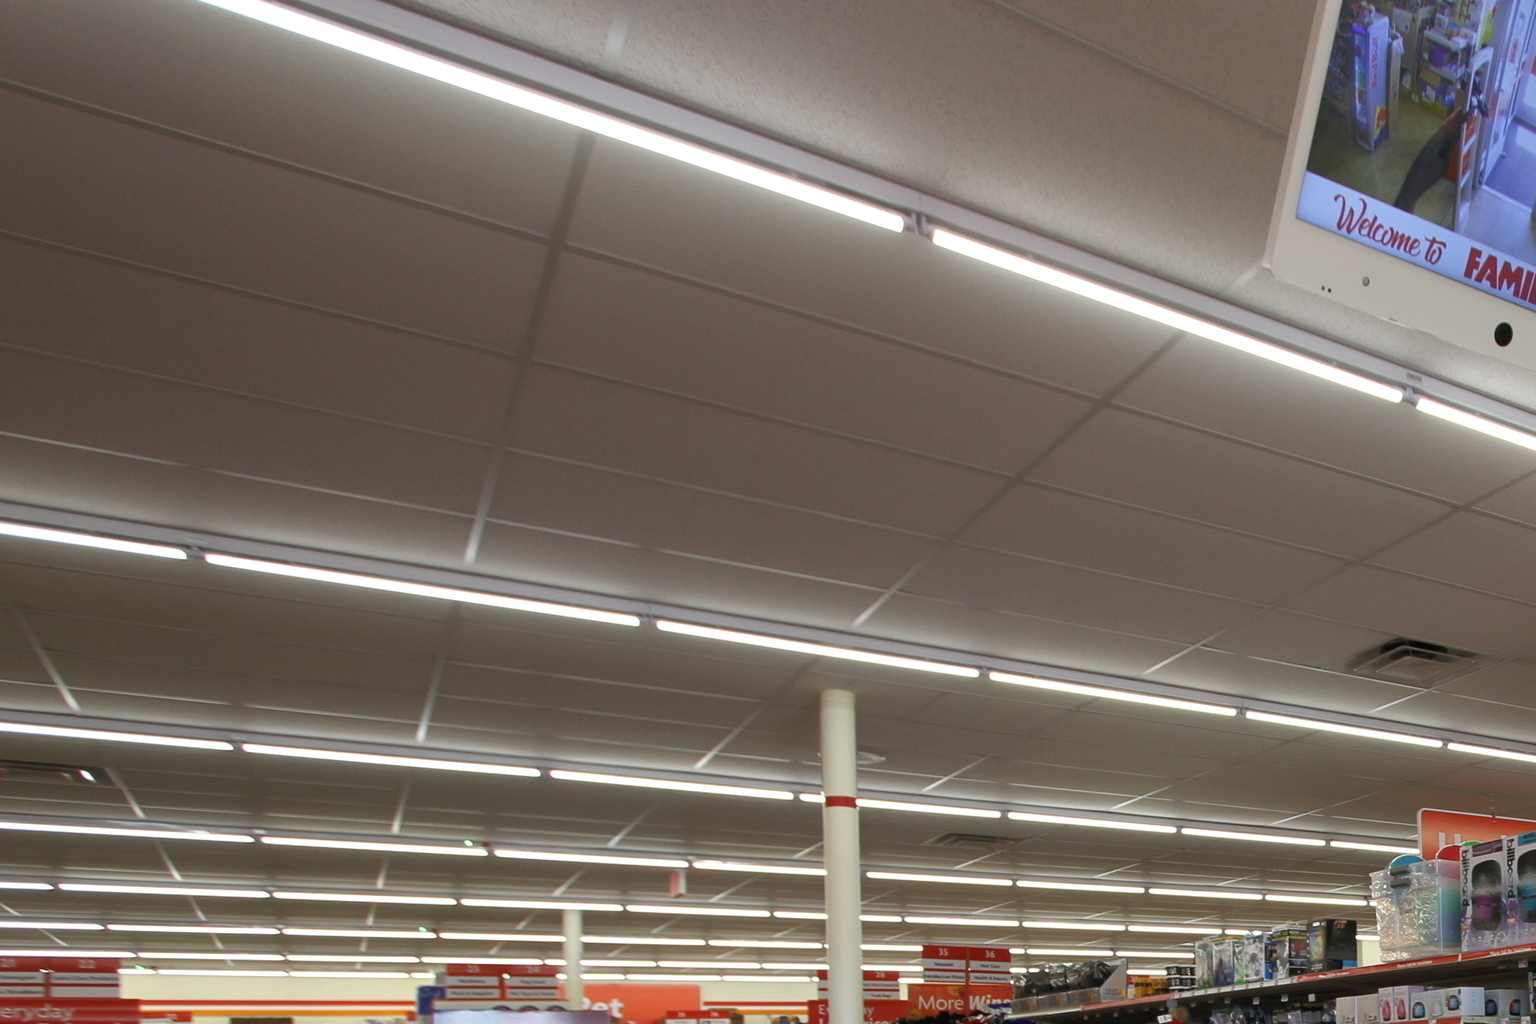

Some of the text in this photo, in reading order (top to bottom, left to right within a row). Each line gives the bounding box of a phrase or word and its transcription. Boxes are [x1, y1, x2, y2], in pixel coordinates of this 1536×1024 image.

[1333, 193, 1447, 265] Welcome to
[938, 947, 949, 957] 35
[985, 950, 996, 959] 36
[918, 994, 965, 1011] More
[0, 1003, 76, 1022] eryday
